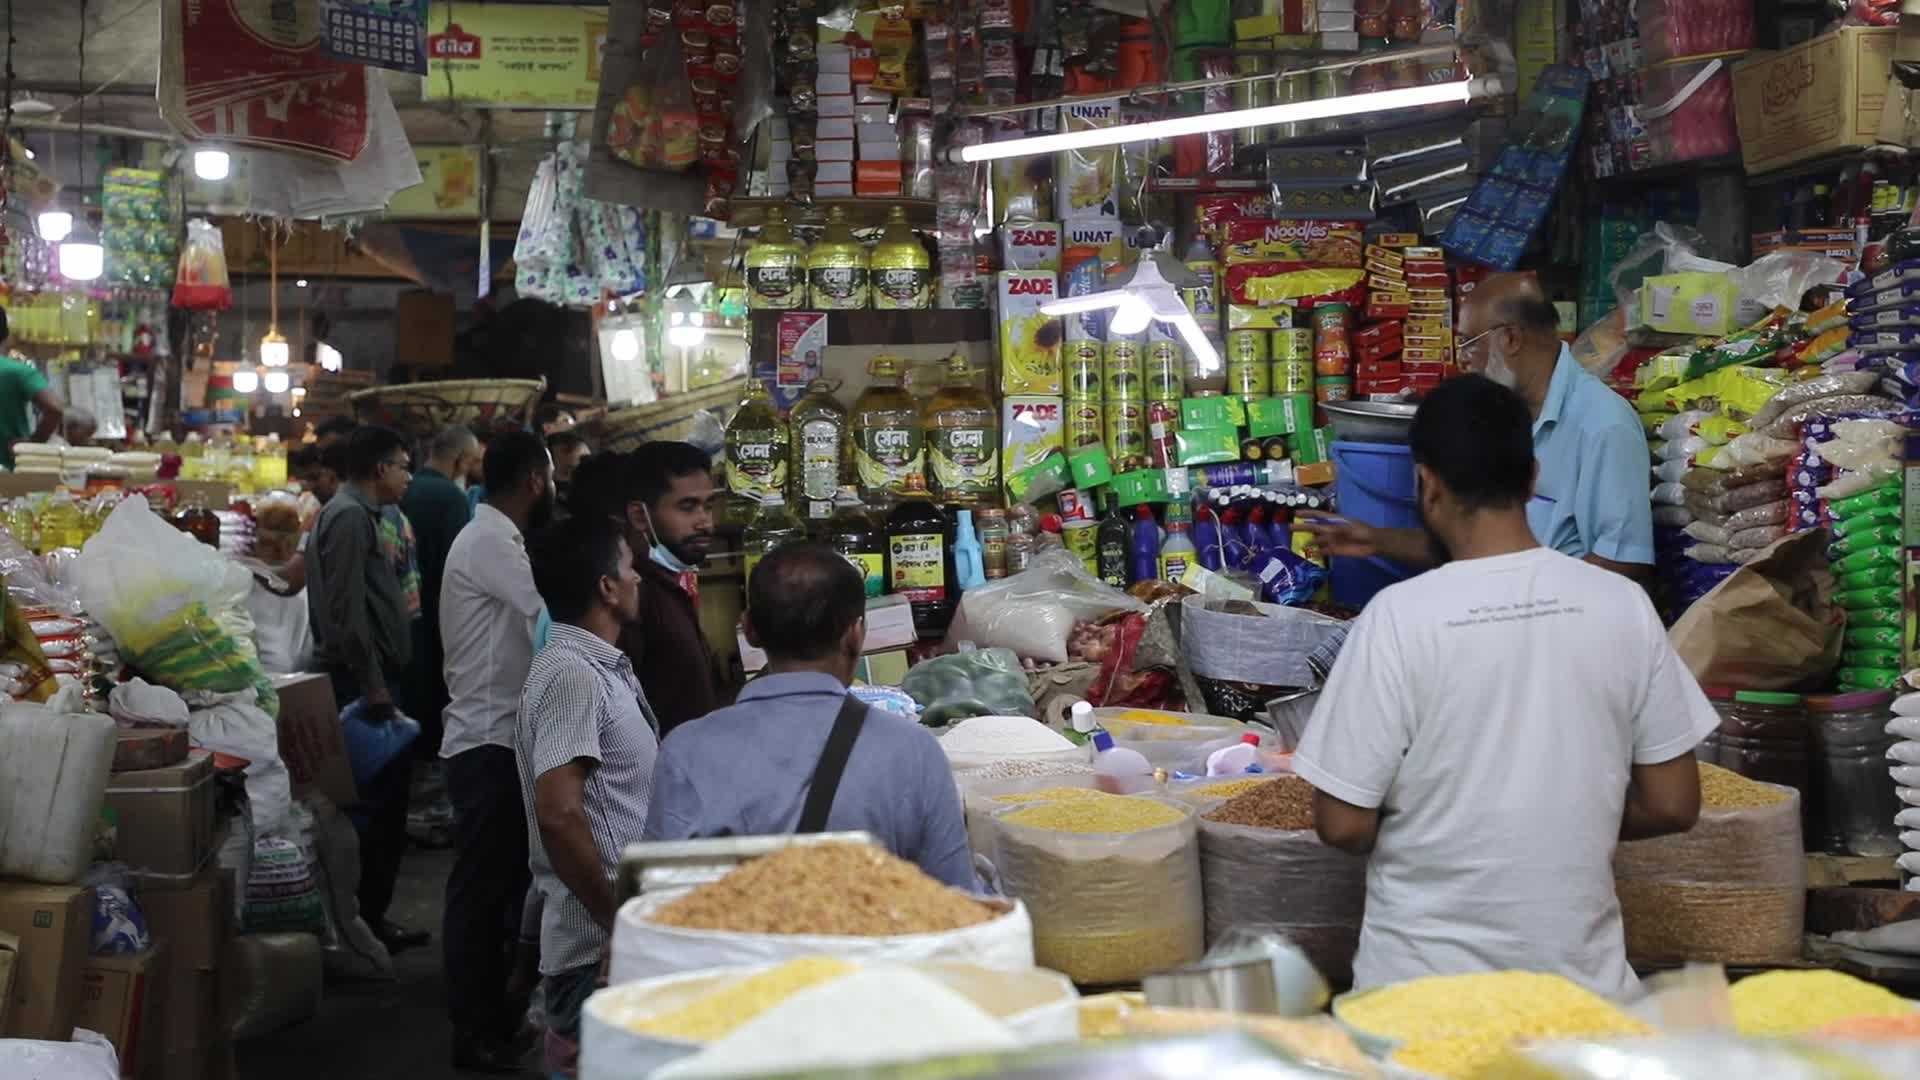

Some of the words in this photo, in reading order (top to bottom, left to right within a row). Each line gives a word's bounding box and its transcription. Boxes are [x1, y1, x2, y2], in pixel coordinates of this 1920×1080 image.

[1071, 105, 1111, 118] UNAT
[1012, 229, 1056, 246] ZADE
[1073, 230, 1113, 243] UNAT
[1264, 220, 1327, 243] Noodles
[1008, 278, 1053, 295] ZADE
